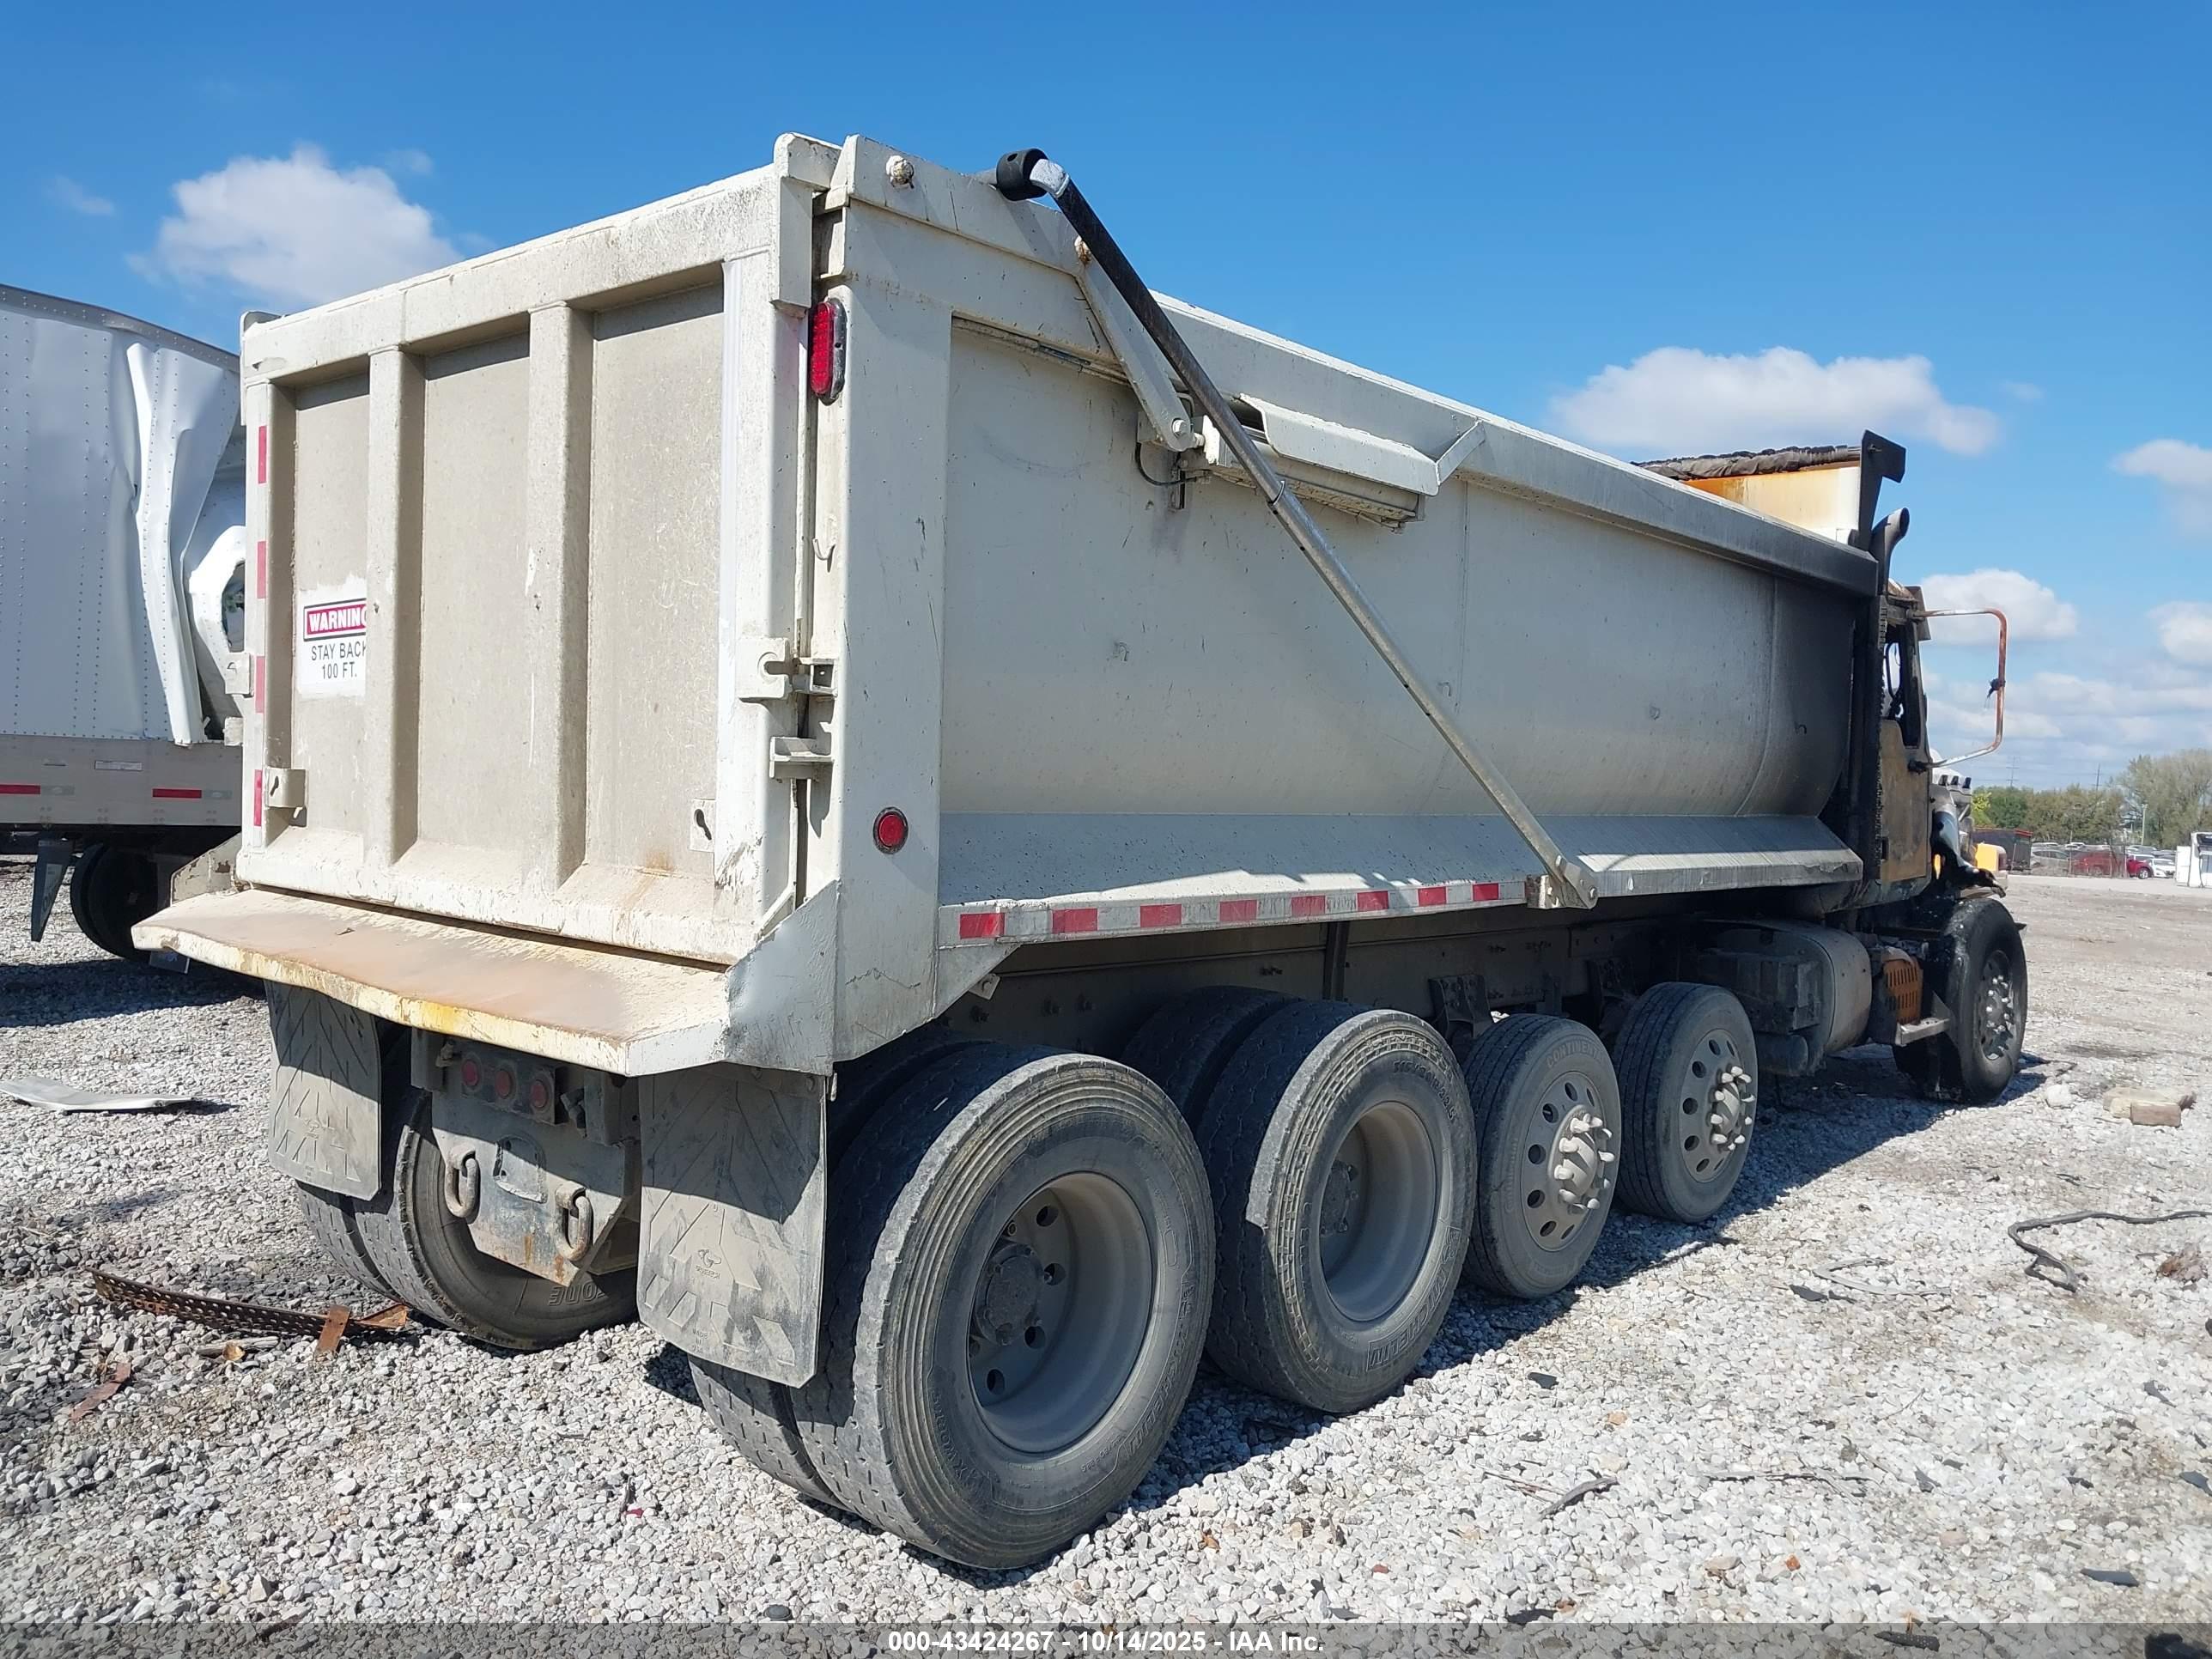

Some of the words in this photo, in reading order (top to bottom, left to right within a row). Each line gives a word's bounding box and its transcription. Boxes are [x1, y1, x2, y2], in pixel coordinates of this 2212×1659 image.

[311, 643, 335, 660] STAY
[322, 663, 338, 679] 100
[343, 661, 357, 678] FT.
